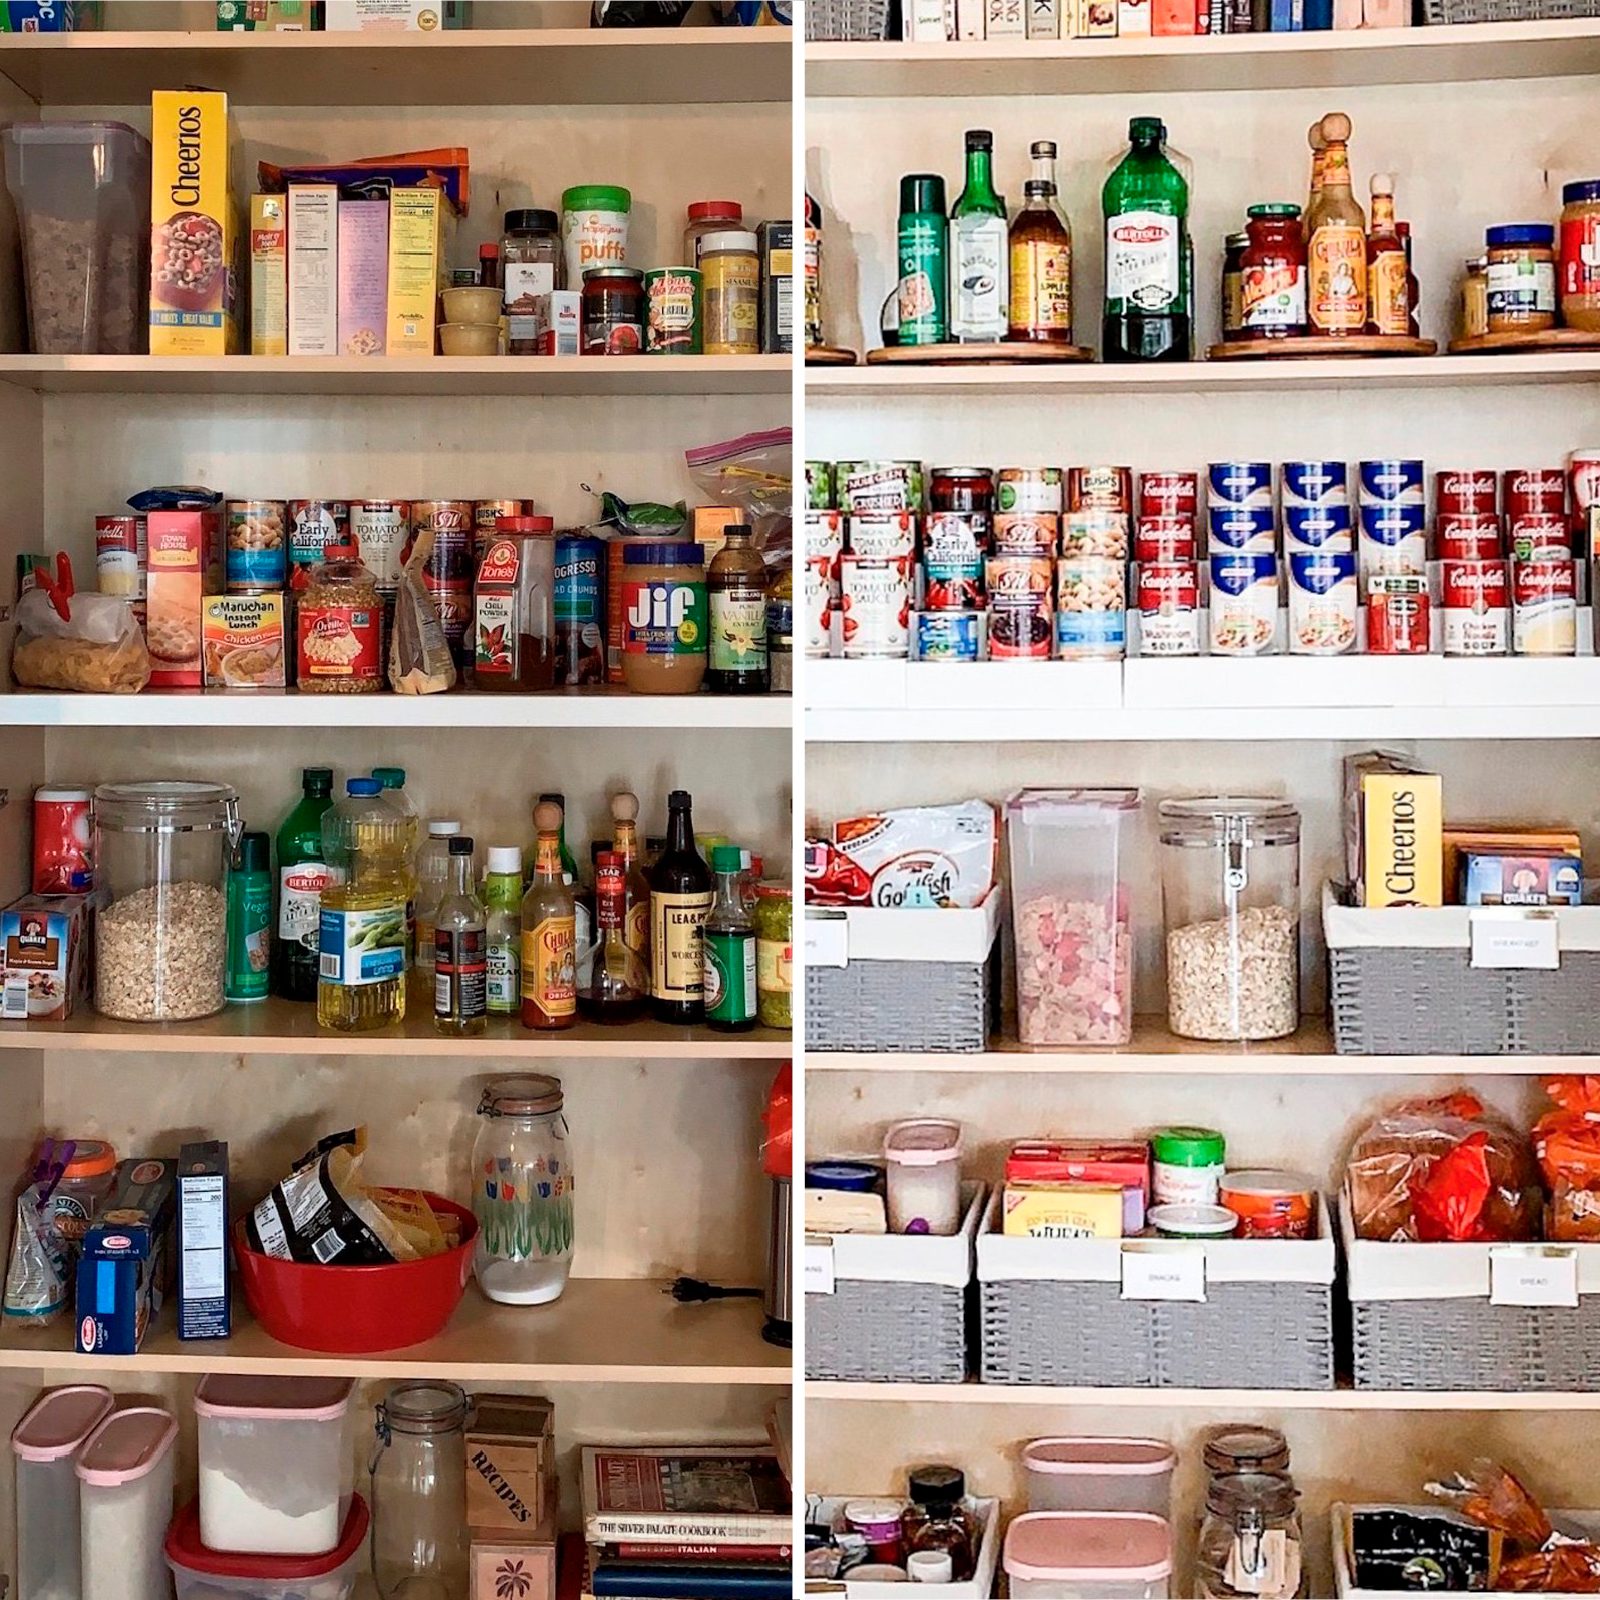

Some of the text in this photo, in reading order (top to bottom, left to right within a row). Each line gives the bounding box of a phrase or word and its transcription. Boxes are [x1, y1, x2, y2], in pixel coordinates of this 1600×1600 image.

[171, 106, 201, 207] Cheerios
[580, 240, 625, 264] puffs
[299, 523, 329, 540] Early
[356, 525, 400, 534] TOMATO
[291, 535, 340, 547] California
[361, 534, 394, 543] SAUCE
[160, 542, 187, 550] HOUSE
[482, 565, 514, 578] Tone's
[554, 560, 596, 579] OGRESSO
[221, 601, 275, 613] Maruchan
[628, 587, 696, 628] Jif
[224, 613, 262, 622] Instant
[228, 621, 258, 629] Lunch
[224, 633, 263, 645] Chicken
[1463, 641, 1497, 650] SOUP
[1385, 790, 1416, 895] Cheerios
[598, 869, 620, 877] STAR
[1502, 893, 1548, 905] QUAKER
[20, 935, 47, 944] QUAKER
[471, 1449, 532, 1524] RECIPES
[599, 1522, 727, 1537] THE SILVER PALATE COOKBOOK
[677, 1545, 717, 1554] ITALIAN
